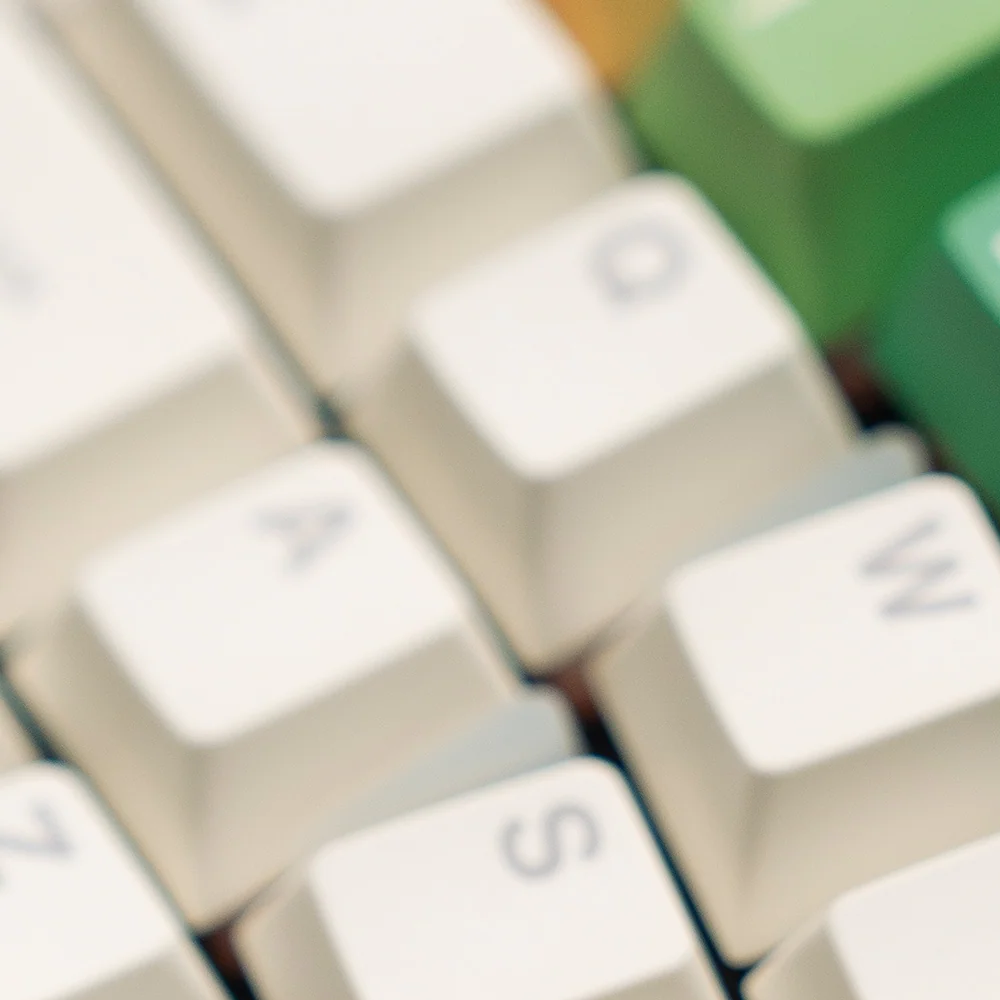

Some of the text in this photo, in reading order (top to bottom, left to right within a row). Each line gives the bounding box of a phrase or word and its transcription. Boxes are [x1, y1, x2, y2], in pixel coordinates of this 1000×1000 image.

[589, 213, 690, 309] Q
[255, 501, 358, 572] A
[857, 514, 978, 619] W
[500, 803, 603, 880] S
